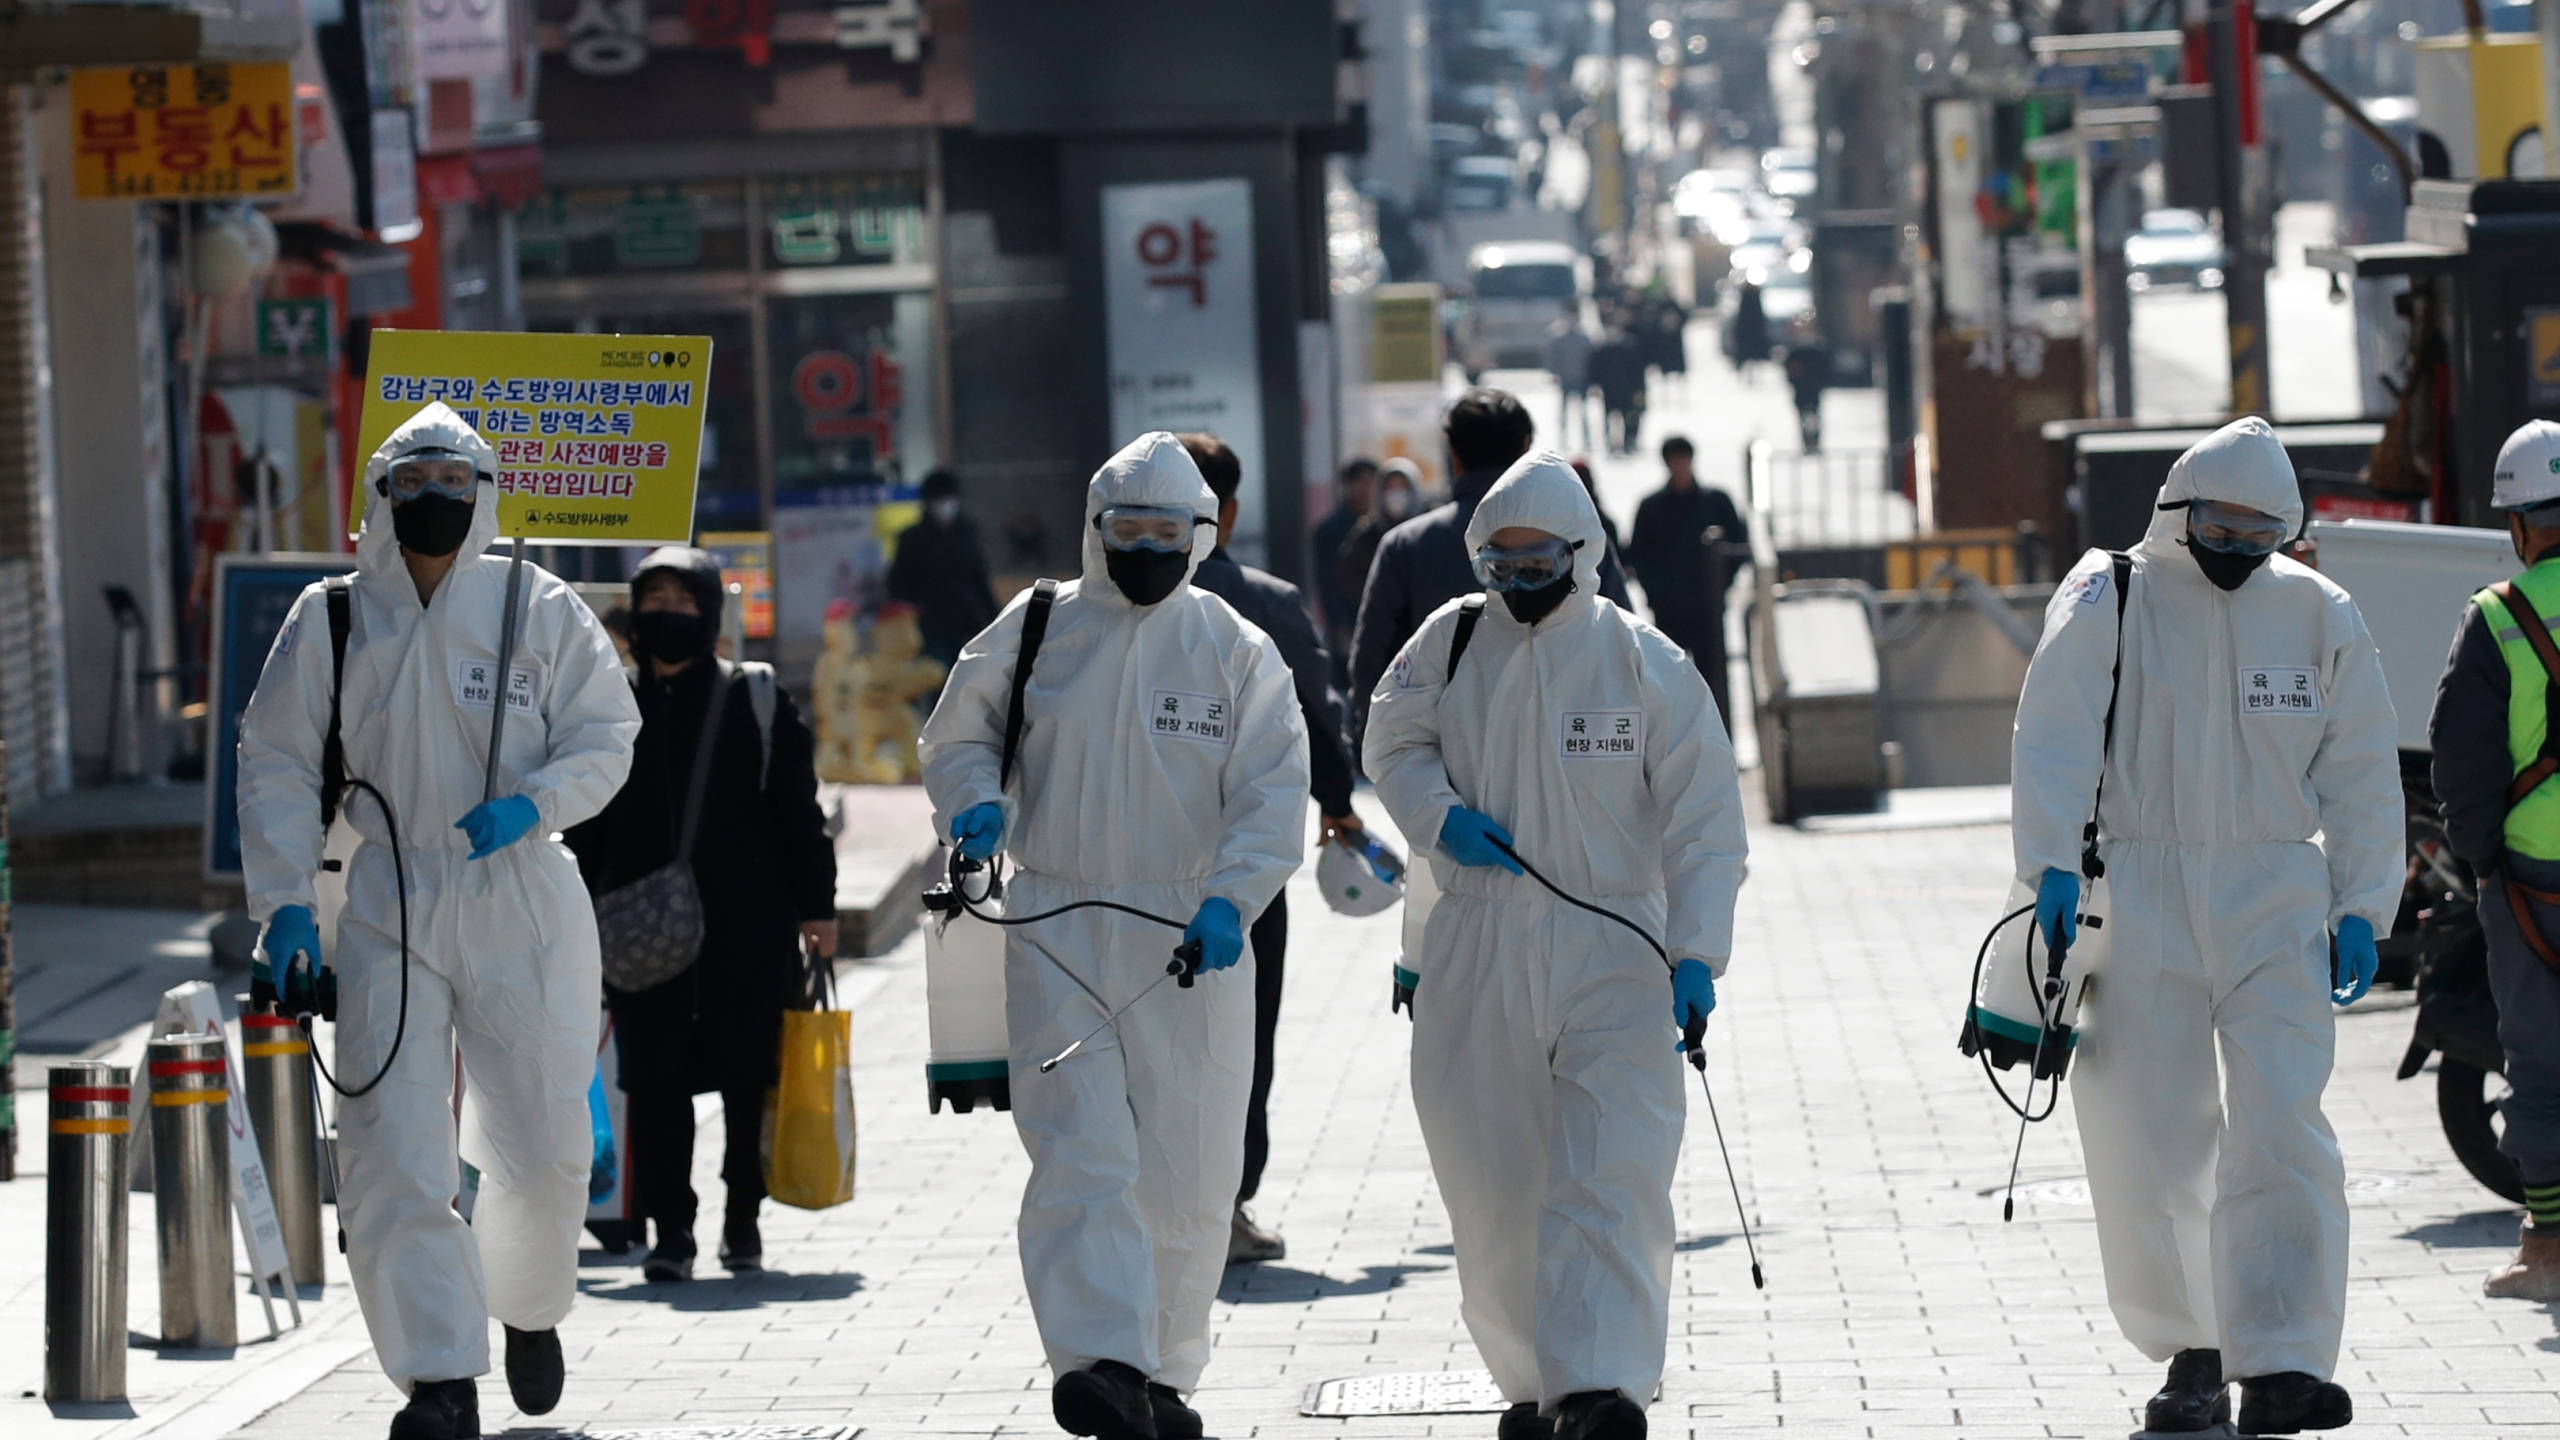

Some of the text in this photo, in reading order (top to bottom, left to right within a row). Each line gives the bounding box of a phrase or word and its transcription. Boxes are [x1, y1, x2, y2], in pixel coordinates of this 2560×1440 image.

[78, 103, 289, 174] 부동산
[1135, 217, 1219, 309] 약
[381, 376, 691, 407] 강남구와 수도방위사령부에서
[793, 350, 905, 460] 약
[486, 410, 532, 433] 하는
[540, 411, 632, 436] 방역소독
[500, 440, 667, 467] 관련 사전예방을
[498, 471, 633, 497] 역작업입니다
[543, 511, 629, 526] 수도방위사령부
[470, 667, 528, 689] 육 군
[2252, 673, 2308, 690] 육 군
[463, 686, 489, 701] 현장
[2247, 693, 2313, 708] 현장 지원팀
[1162, 696, 1223, 720] 육 군
[1155, 716, 1224, 738] 현장 지원팀
[1571, 717, 1631, 734] 육 군
[1566, 738, 1634, 752] 현장 지원팀
